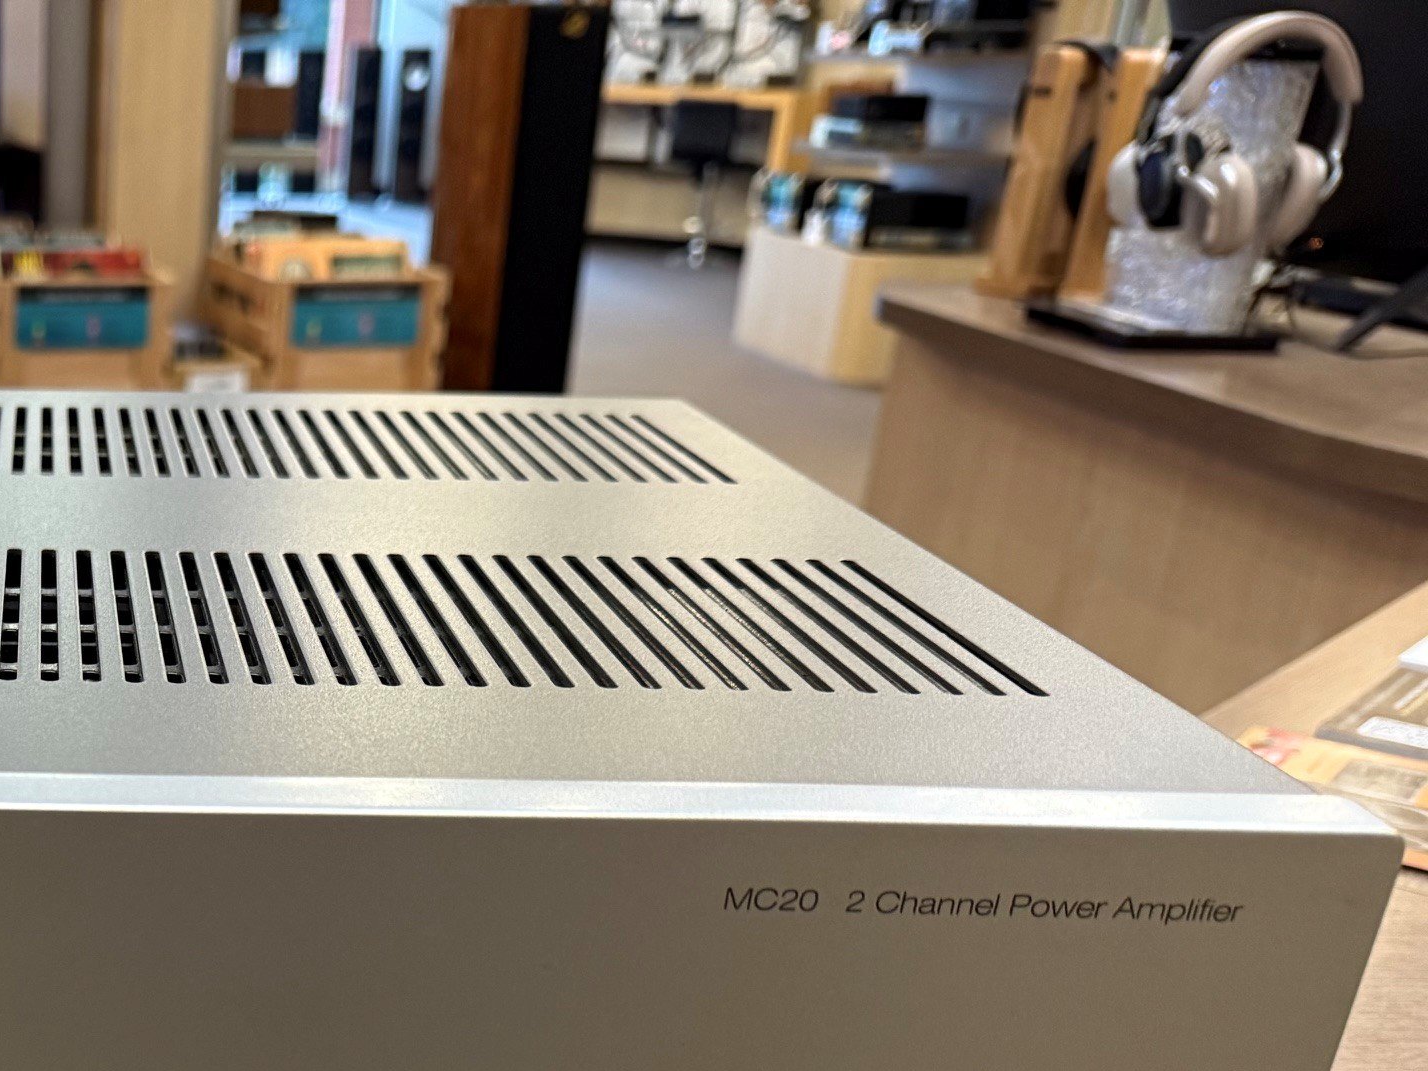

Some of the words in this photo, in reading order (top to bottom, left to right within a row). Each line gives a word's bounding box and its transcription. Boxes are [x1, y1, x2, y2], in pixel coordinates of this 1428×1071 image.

[723, 887, 819, 912] MC20
[845, 890, 865, 913] 2
[875, 890, 1000, 917] Channel
[1009, 893, 1108, 919] Power
[1112, 896, 1244, 925] Amplifier
